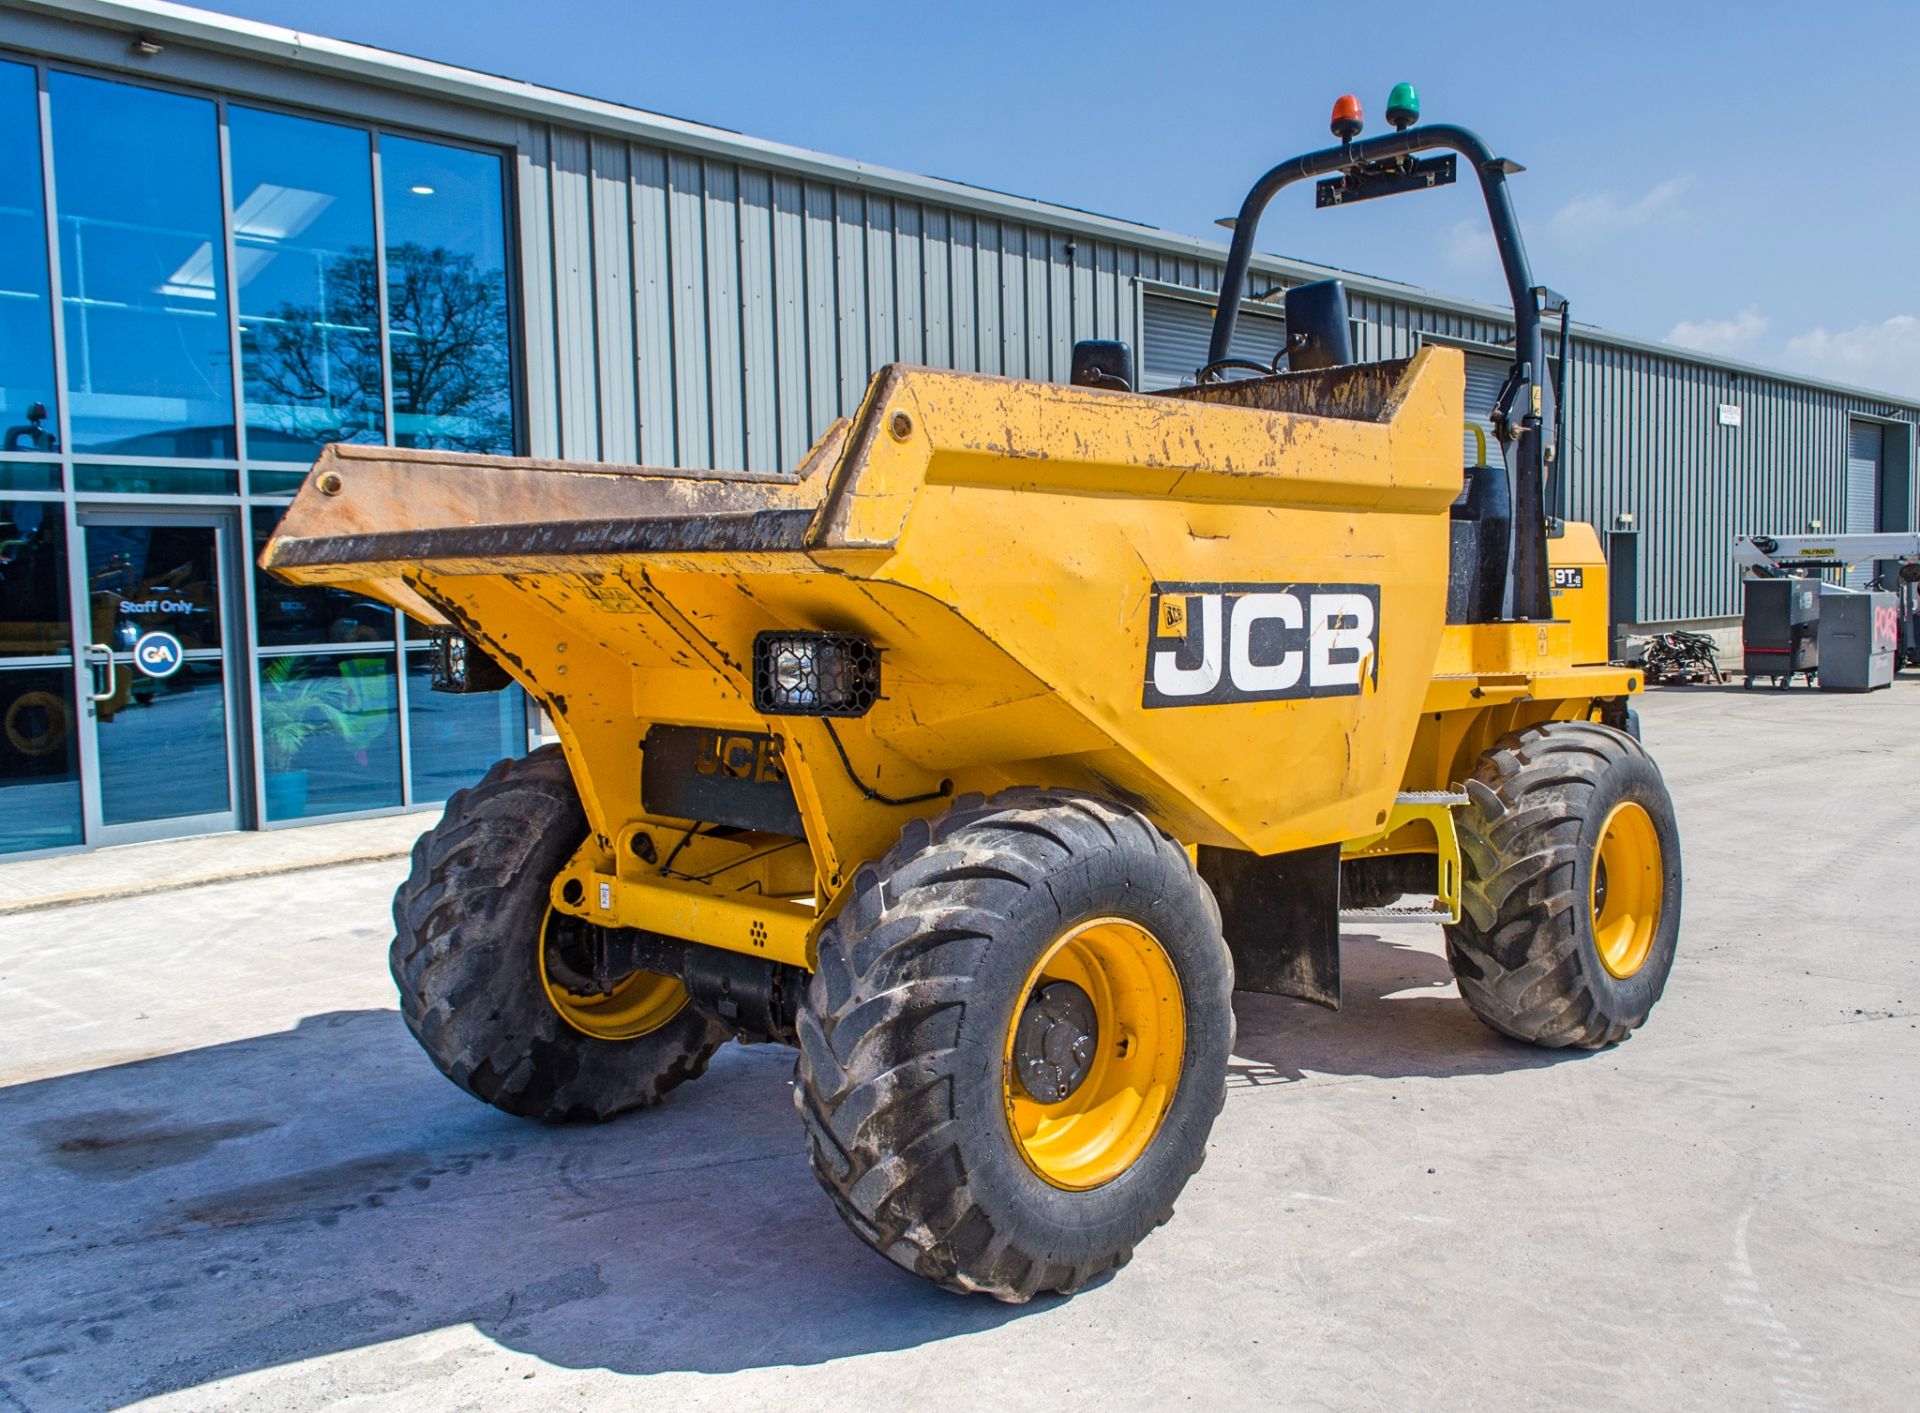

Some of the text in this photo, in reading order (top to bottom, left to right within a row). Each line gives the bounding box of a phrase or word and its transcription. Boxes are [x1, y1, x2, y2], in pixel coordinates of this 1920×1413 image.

[120, 600, 193, 615] Staff Only
[142, 646, 174, 663] GA
[1154, 593, 1374, 696] JCB
[696, 735, 785, 783] JCB
